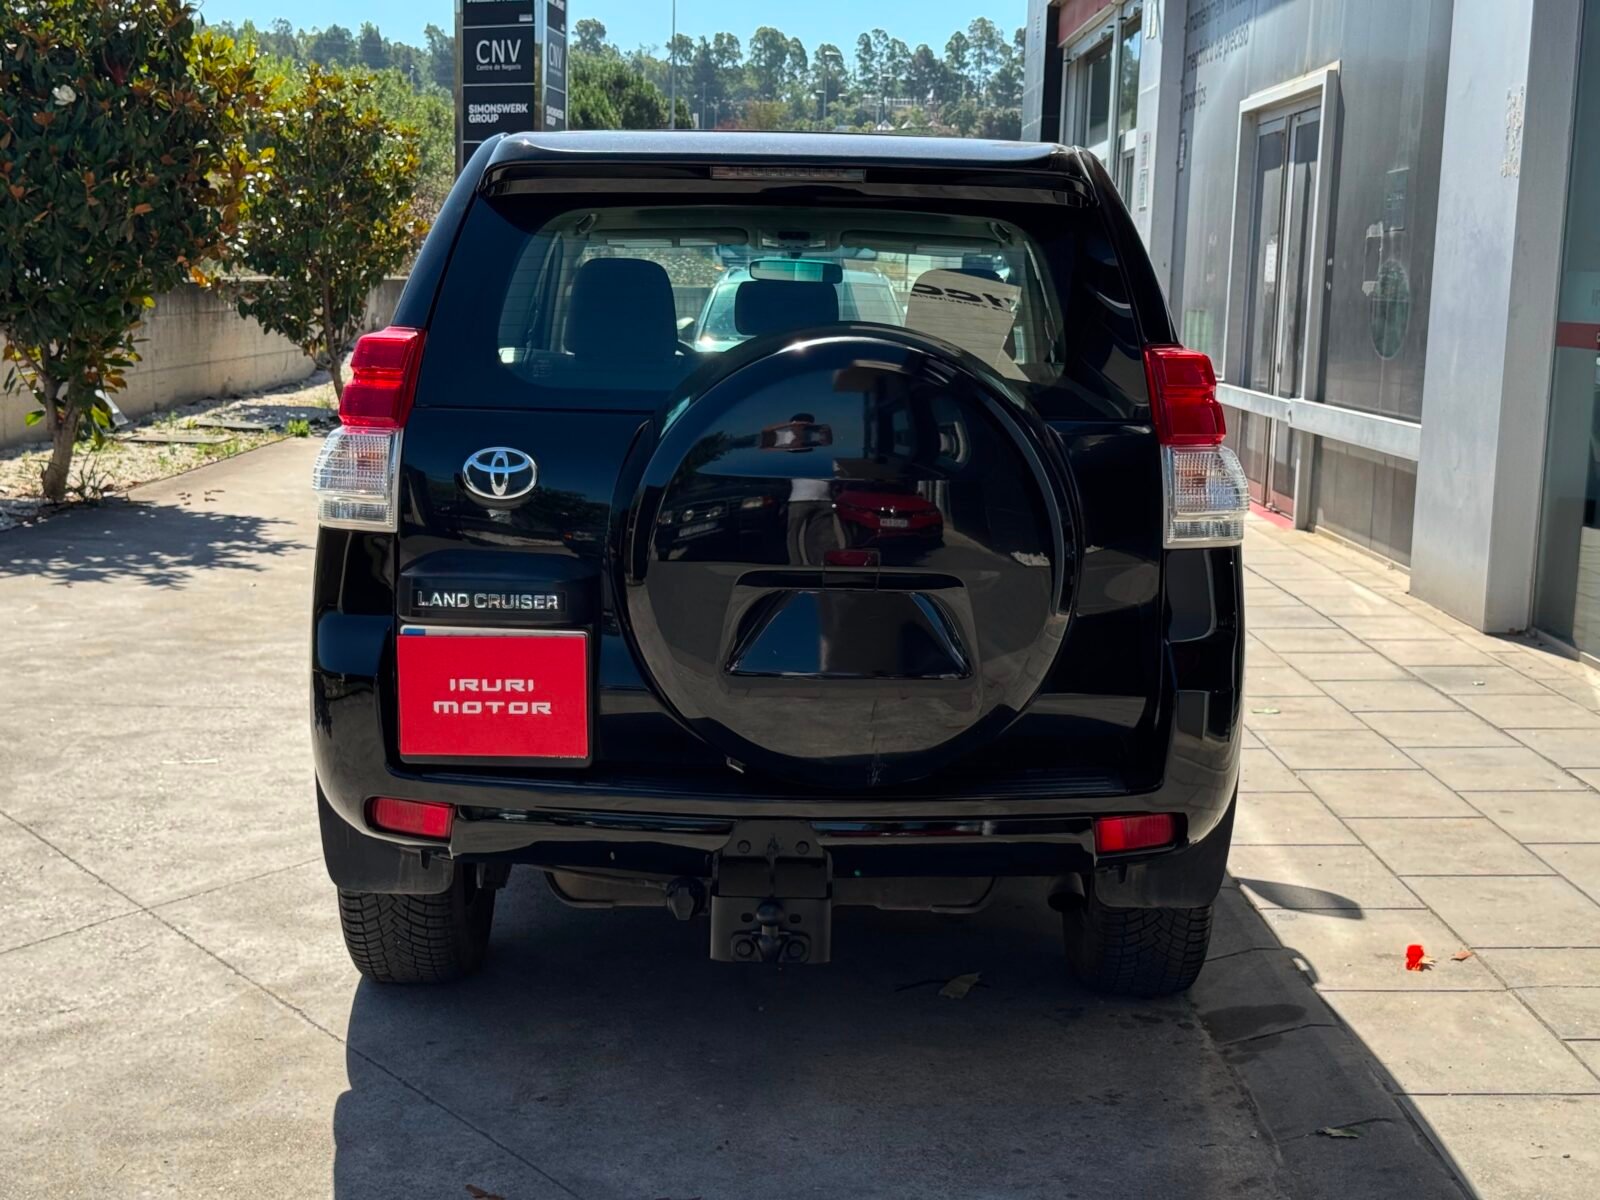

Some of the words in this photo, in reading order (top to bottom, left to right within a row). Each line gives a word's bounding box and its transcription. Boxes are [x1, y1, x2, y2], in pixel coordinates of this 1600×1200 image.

[476, 39, 521, 64] CNV
[468, 103, 528, 114] SIMONSWERK
[468, 114, 499, 124] GROUP
[417, 591, 470, 609] LAND
[474, 593, 558, 610] CRUISER
[449, 678, 535, 692] IRURI
[433, 701, 552, 715] MOTOR
